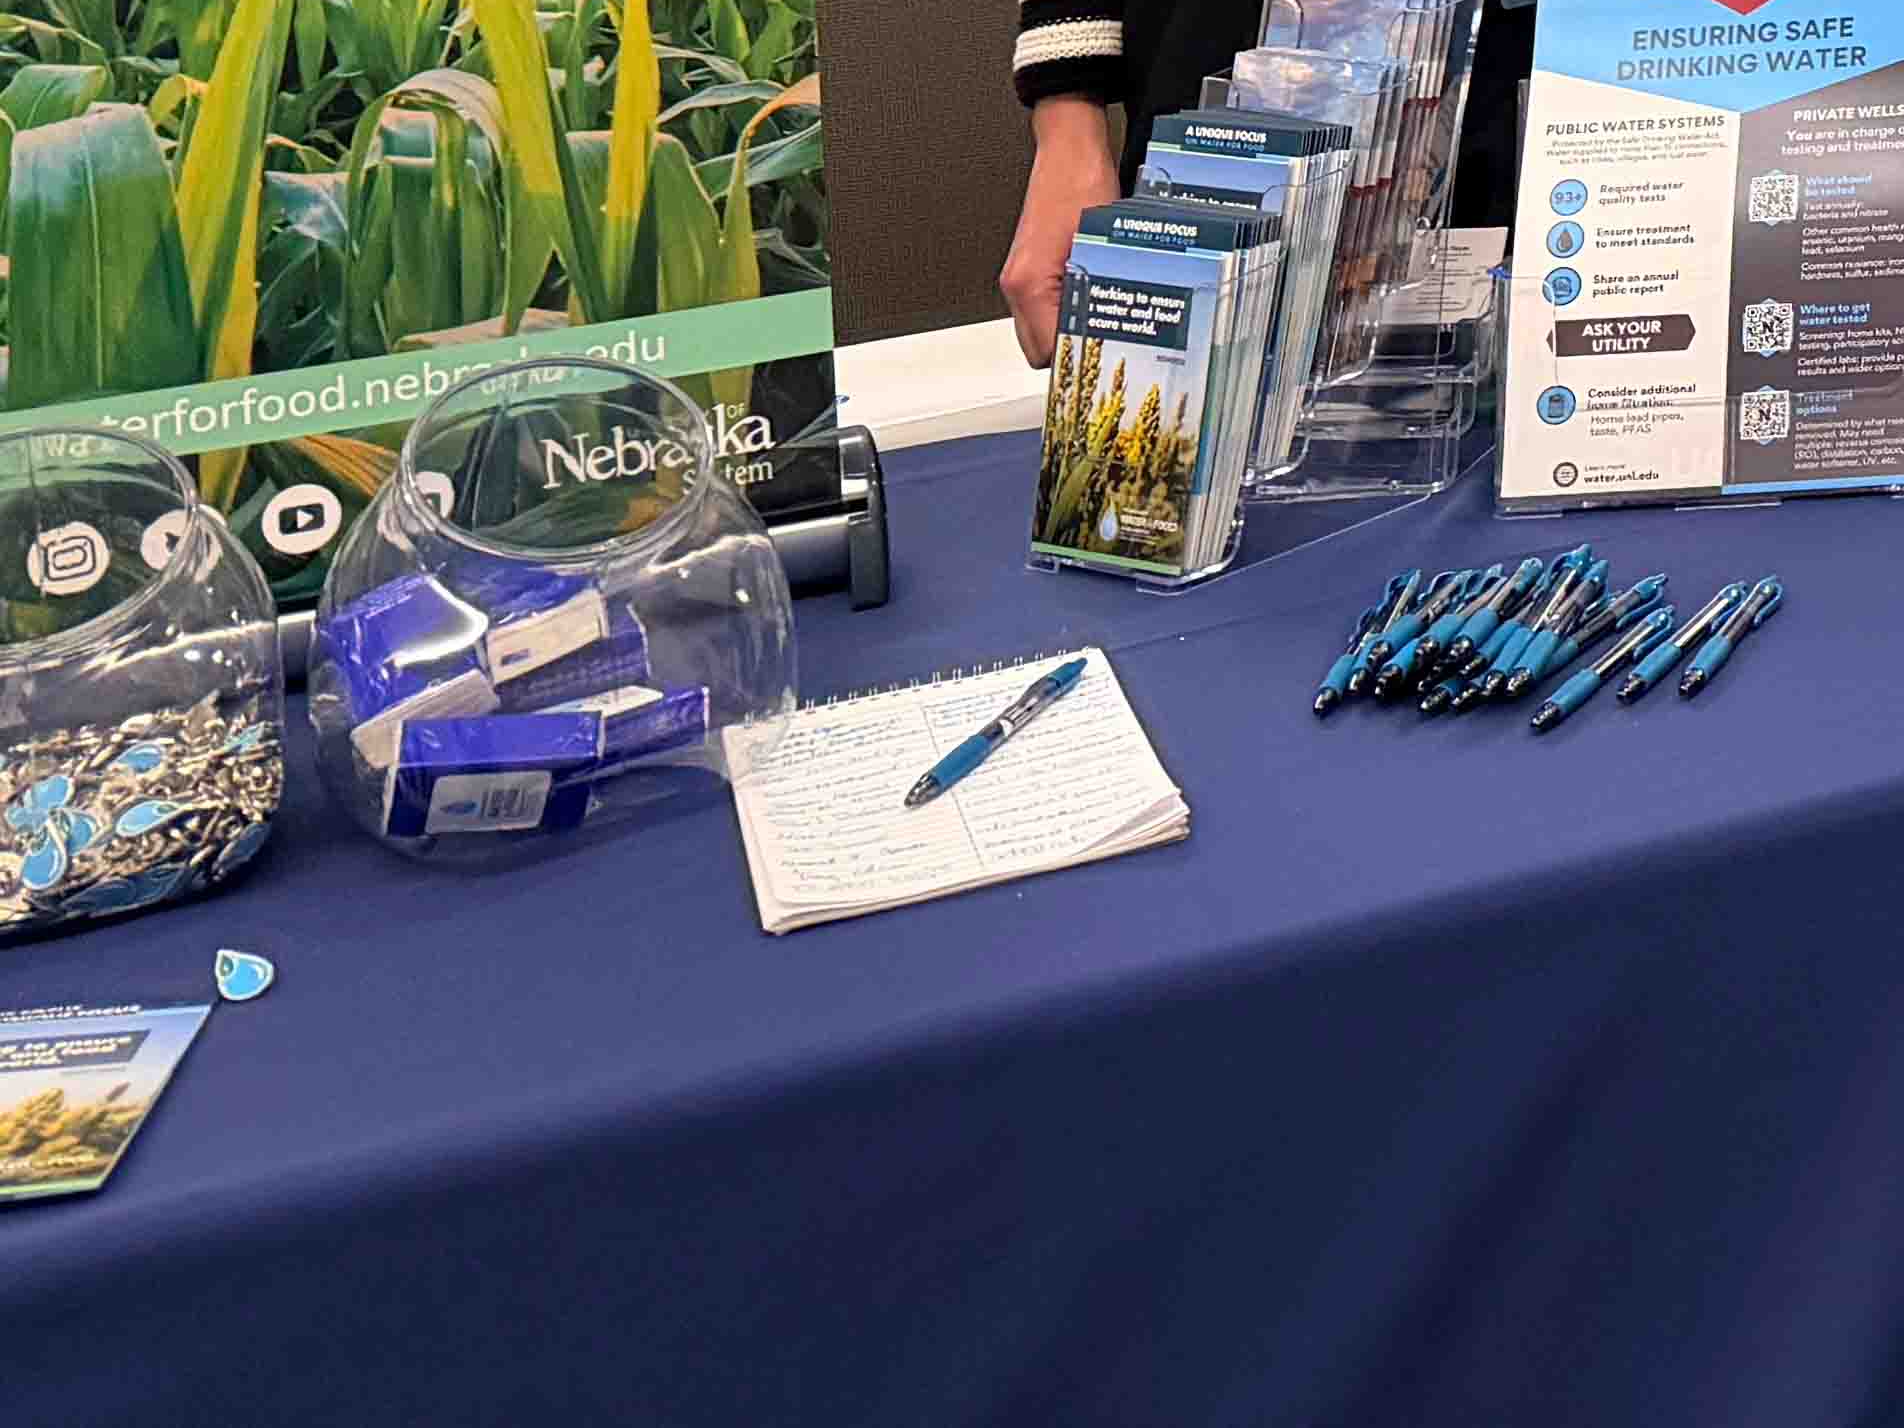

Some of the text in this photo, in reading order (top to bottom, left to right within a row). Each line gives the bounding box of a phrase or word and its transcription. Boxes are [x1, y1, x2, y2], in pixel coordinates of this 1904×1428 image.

[1633, 17, 1855, 51] ENSURING SAFE
[1617, 46, 1867, 81] DRINKING WATER
[1793, 107, 1855, 121] PRIVATE
[1546, 115, 1725, 136] PUBLIC WATER SYSTEMS
[1185, 125, 1194, 136] A
[1235, 129, 1266, 143] FOCUS
[1787, 130, 1812, 142] You
[1816, 130, 1835, 140] are
[1838, 128, 1849, 138] in
[1852, 125, 1894, 139] charge
[1781, 143, 1825, 157] testing
[1827, 141, 1850, 152] and
[1600, 182, 1683, 194] Required water
[1599, 194, 1666, 206] quality tests
[1113, 217, 1122, 228] A
[1164, 223, 1198, 236] FOCUS
[1597, 224, 1691, 237] Ensure treatment
[1596, 235, 1694, 248] to meet standards
[1593, 270, 1679, 284] Share an annual
[1136, 292, 1147, 303] to
[1592, 284, 1664, 298] public report
[1097, 304, 1181, 323] water and food
[1800, 303, 1871, 314] Where to get
[1088, 317, 1157, 335] ecure world.
[1800, 313, 1868, 325] water tested
[1582, 320, 1662, 337] ASK YOUR
[1592, 338, 1652, 352] UTILITY
[1588, 384, 1696, 399] Consider additional
[683, 461, 774, 495] Stem
